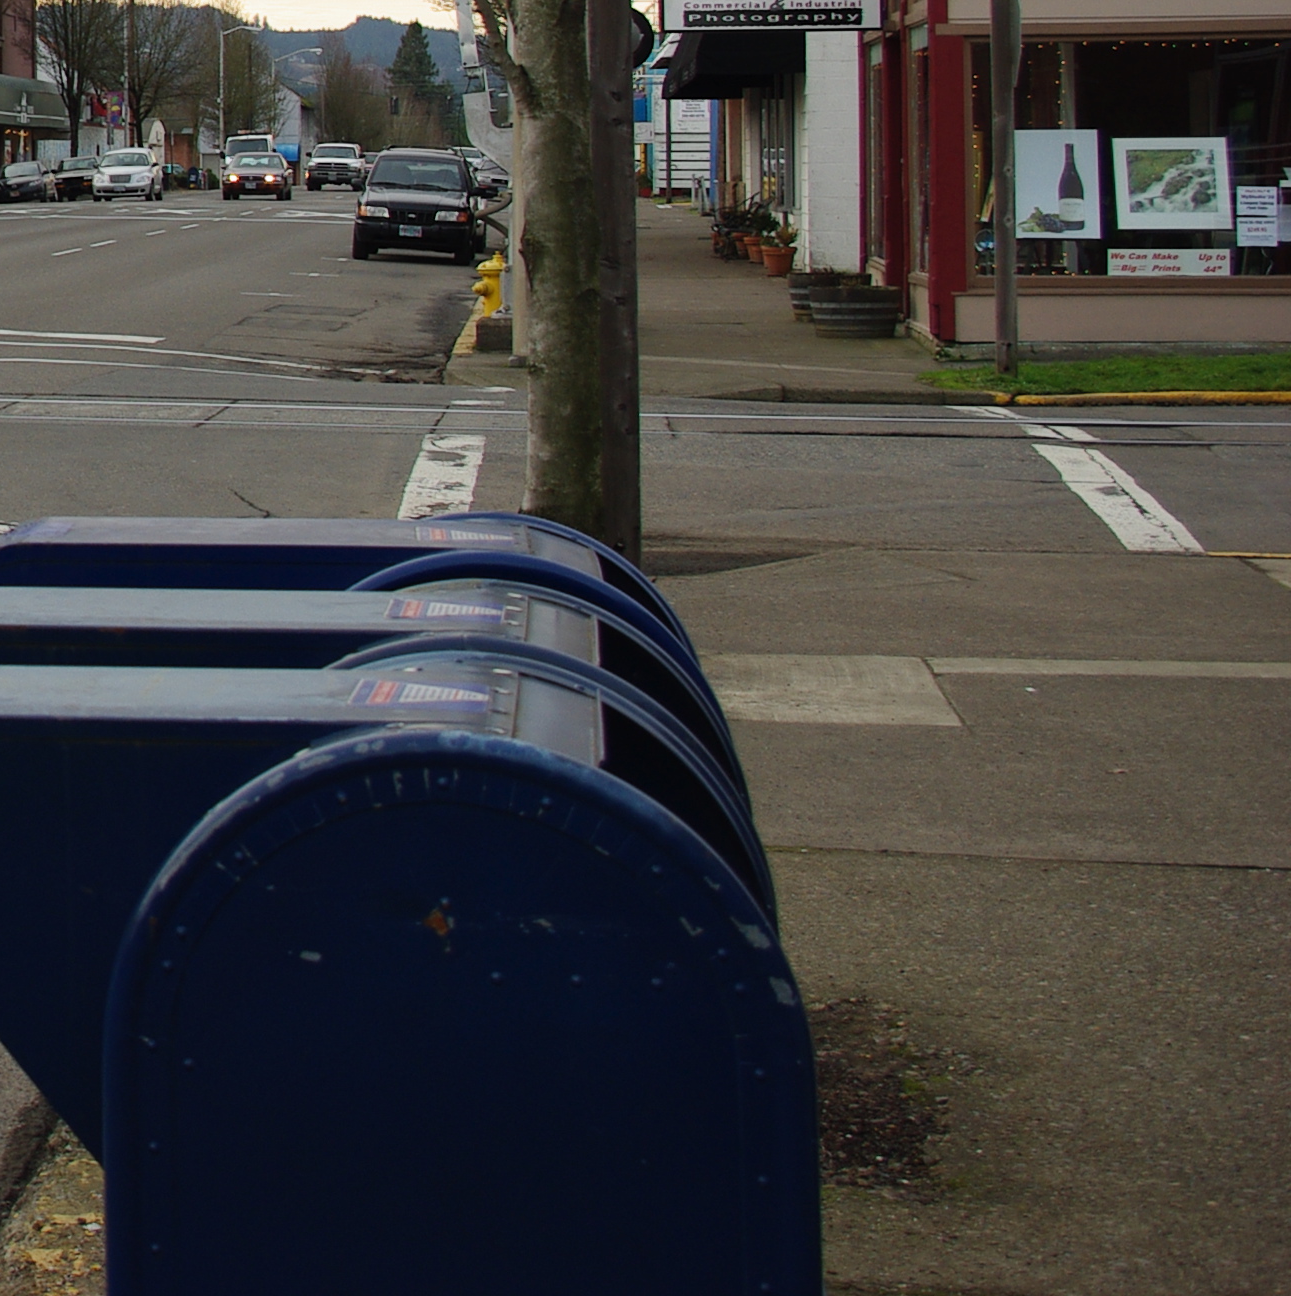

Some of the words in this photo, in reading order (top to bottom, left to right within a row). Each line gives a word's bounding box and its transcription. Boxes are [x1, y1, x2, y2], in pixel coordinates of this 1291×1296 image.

[683, 1, 767, 10] Commercial
[789, 0, 863, 9] Industrial
[687, 12, 861, 25] Photography
[1110, 252, 1126, 261] We
[1128, 252, 1148, 261] Can
[1151, 252, 1179, 261] Make
[1198, 253, 1212, 263] Up
[1215, 253, 1227, 262] to
[1120, 264, 1137, 274] Big
[1151, 264, 1181, 273] Prints
